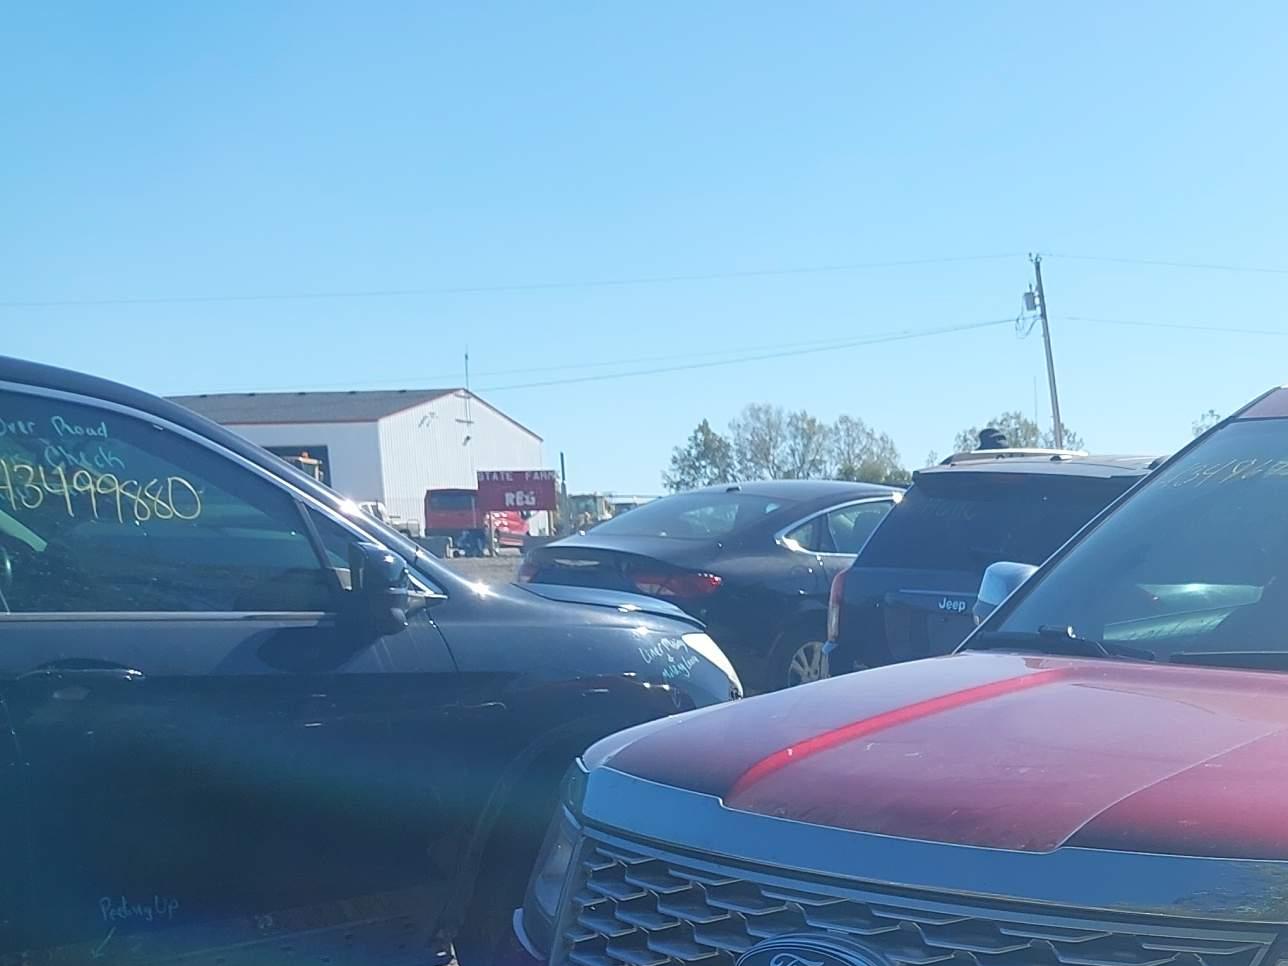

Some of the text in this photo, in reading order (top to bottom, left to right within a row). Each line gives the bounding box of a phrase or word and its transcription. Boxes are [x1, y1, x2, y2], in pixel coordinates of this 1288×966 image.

[478, 471, 513, 481] STATE
[0, 458, 202, 524] 43499880
[938, 597, 966, 612] Jeep
